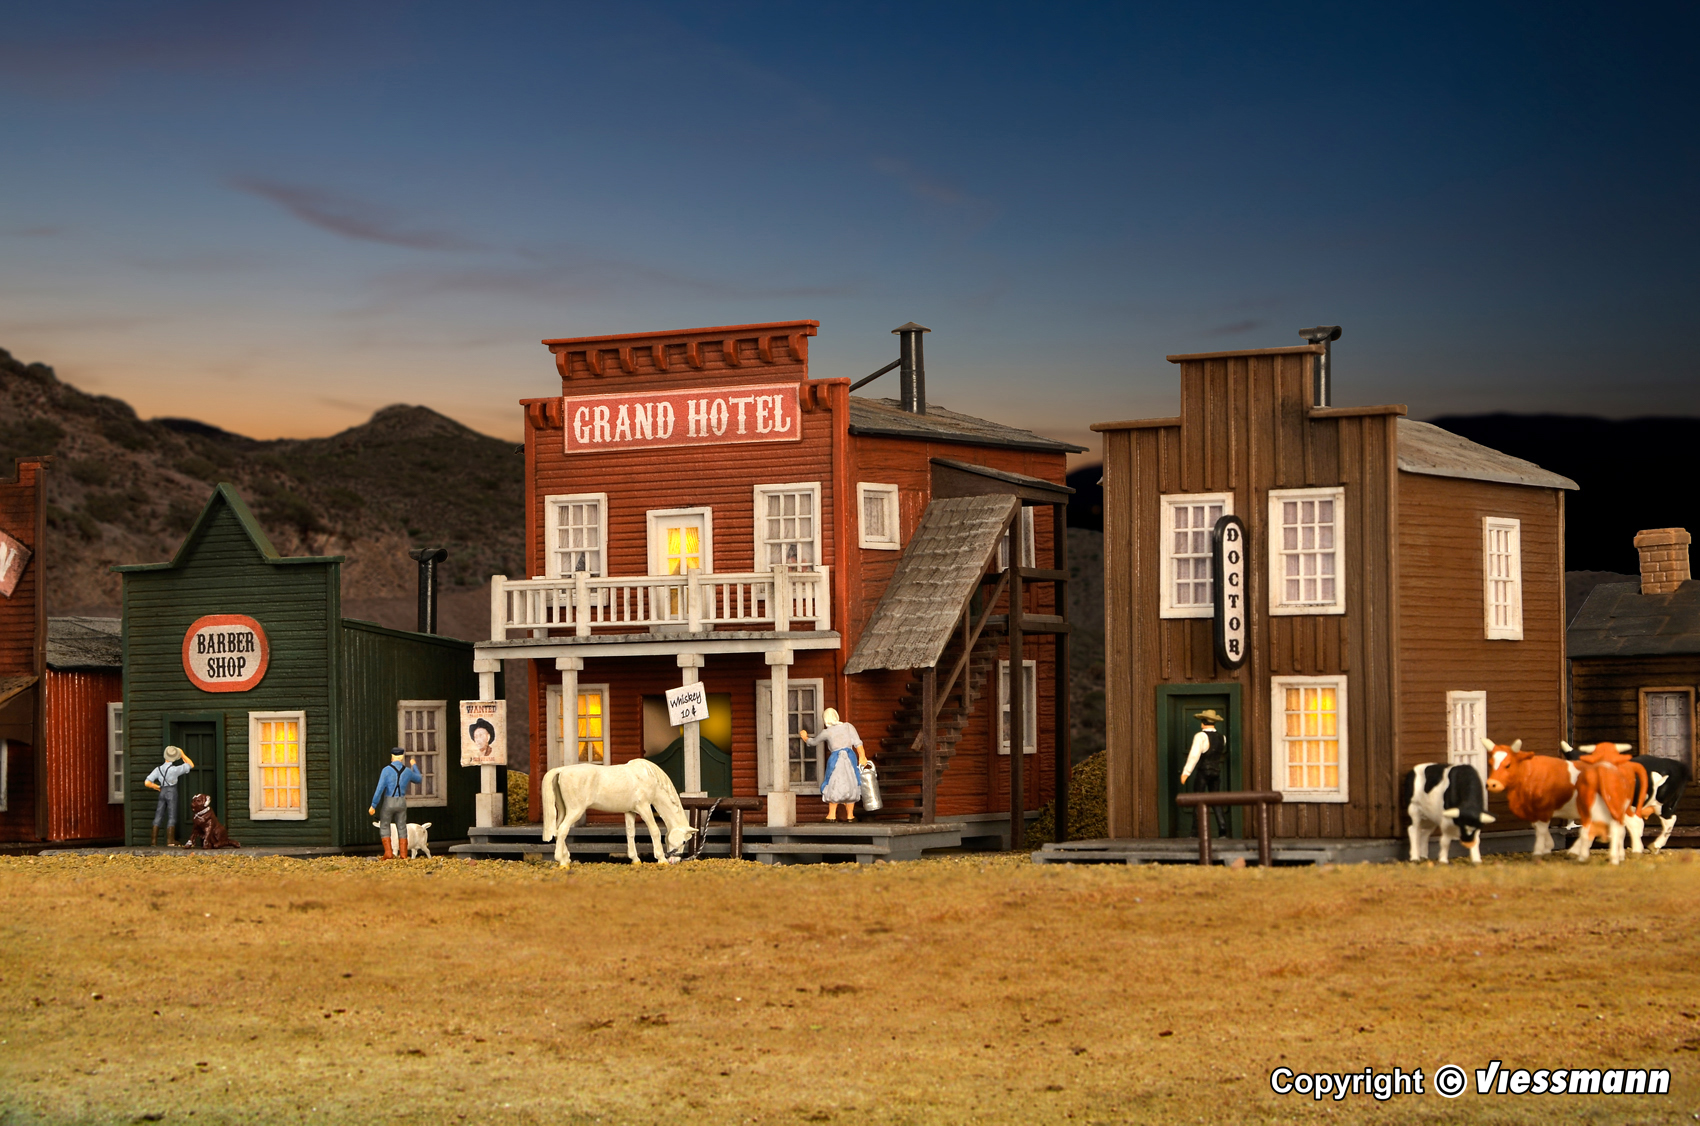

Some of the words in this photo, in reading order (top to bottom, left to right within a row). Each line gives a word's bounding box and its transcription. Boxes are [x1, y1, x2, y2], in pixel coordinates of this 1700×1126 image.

[573, 401, 675, 444] GRAND
[687, 394, 791, 438] HOTEL
[1227, 528, 1240, 655] DOCTOR
[197, 631, 255, 654] BARBER
[207, 656, 246, 678] SHOP
[466, 705, 497, 714] WANTED
[670, 691, 702, 708] Whiskey
